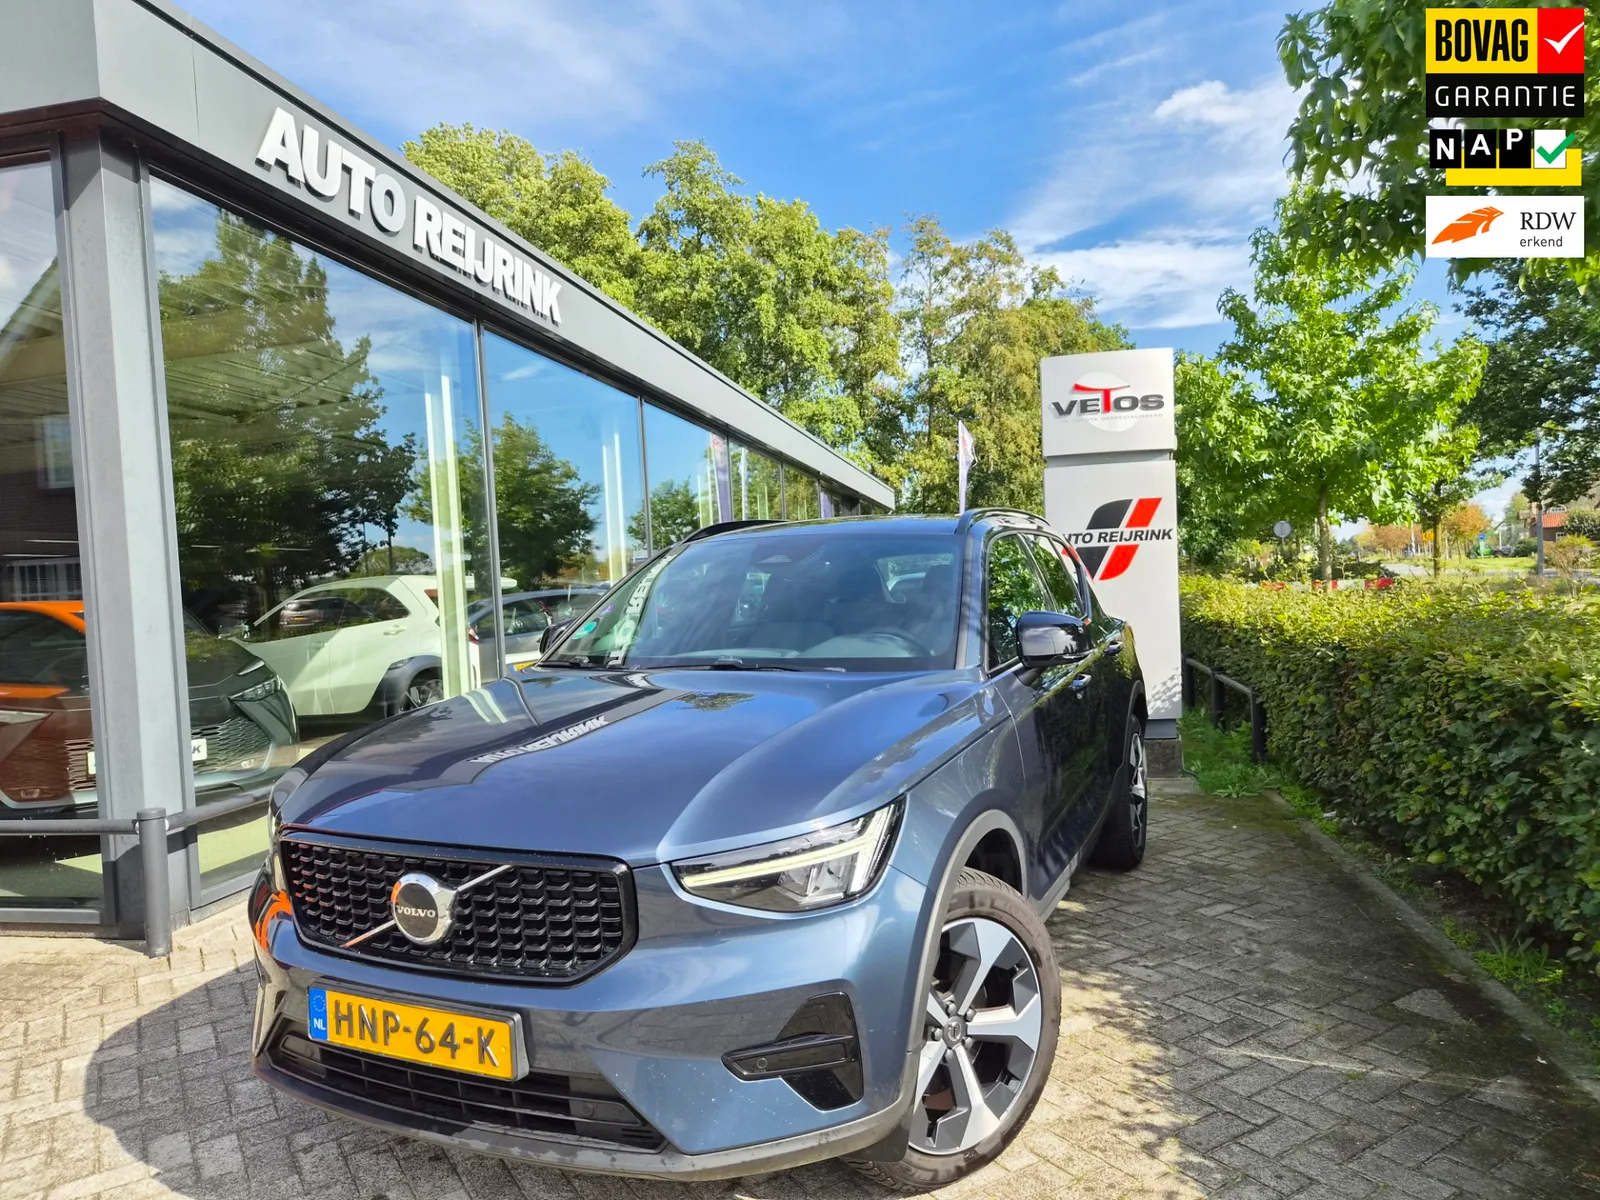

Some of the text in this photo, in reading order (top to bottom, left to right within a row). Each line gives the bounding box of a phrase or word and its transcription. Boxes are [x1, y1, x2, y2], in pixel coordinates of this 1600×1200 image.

[255, 107, 562, 325] AUTO REIJRINK
[1051, 383, 1165, 416] VETOS
[1062, 528, 1173, 545] UTO REIJRINK
[396, 905, 436, 918] VOLVO
[313, 999, 499, 1068] NL HNP-64-K
